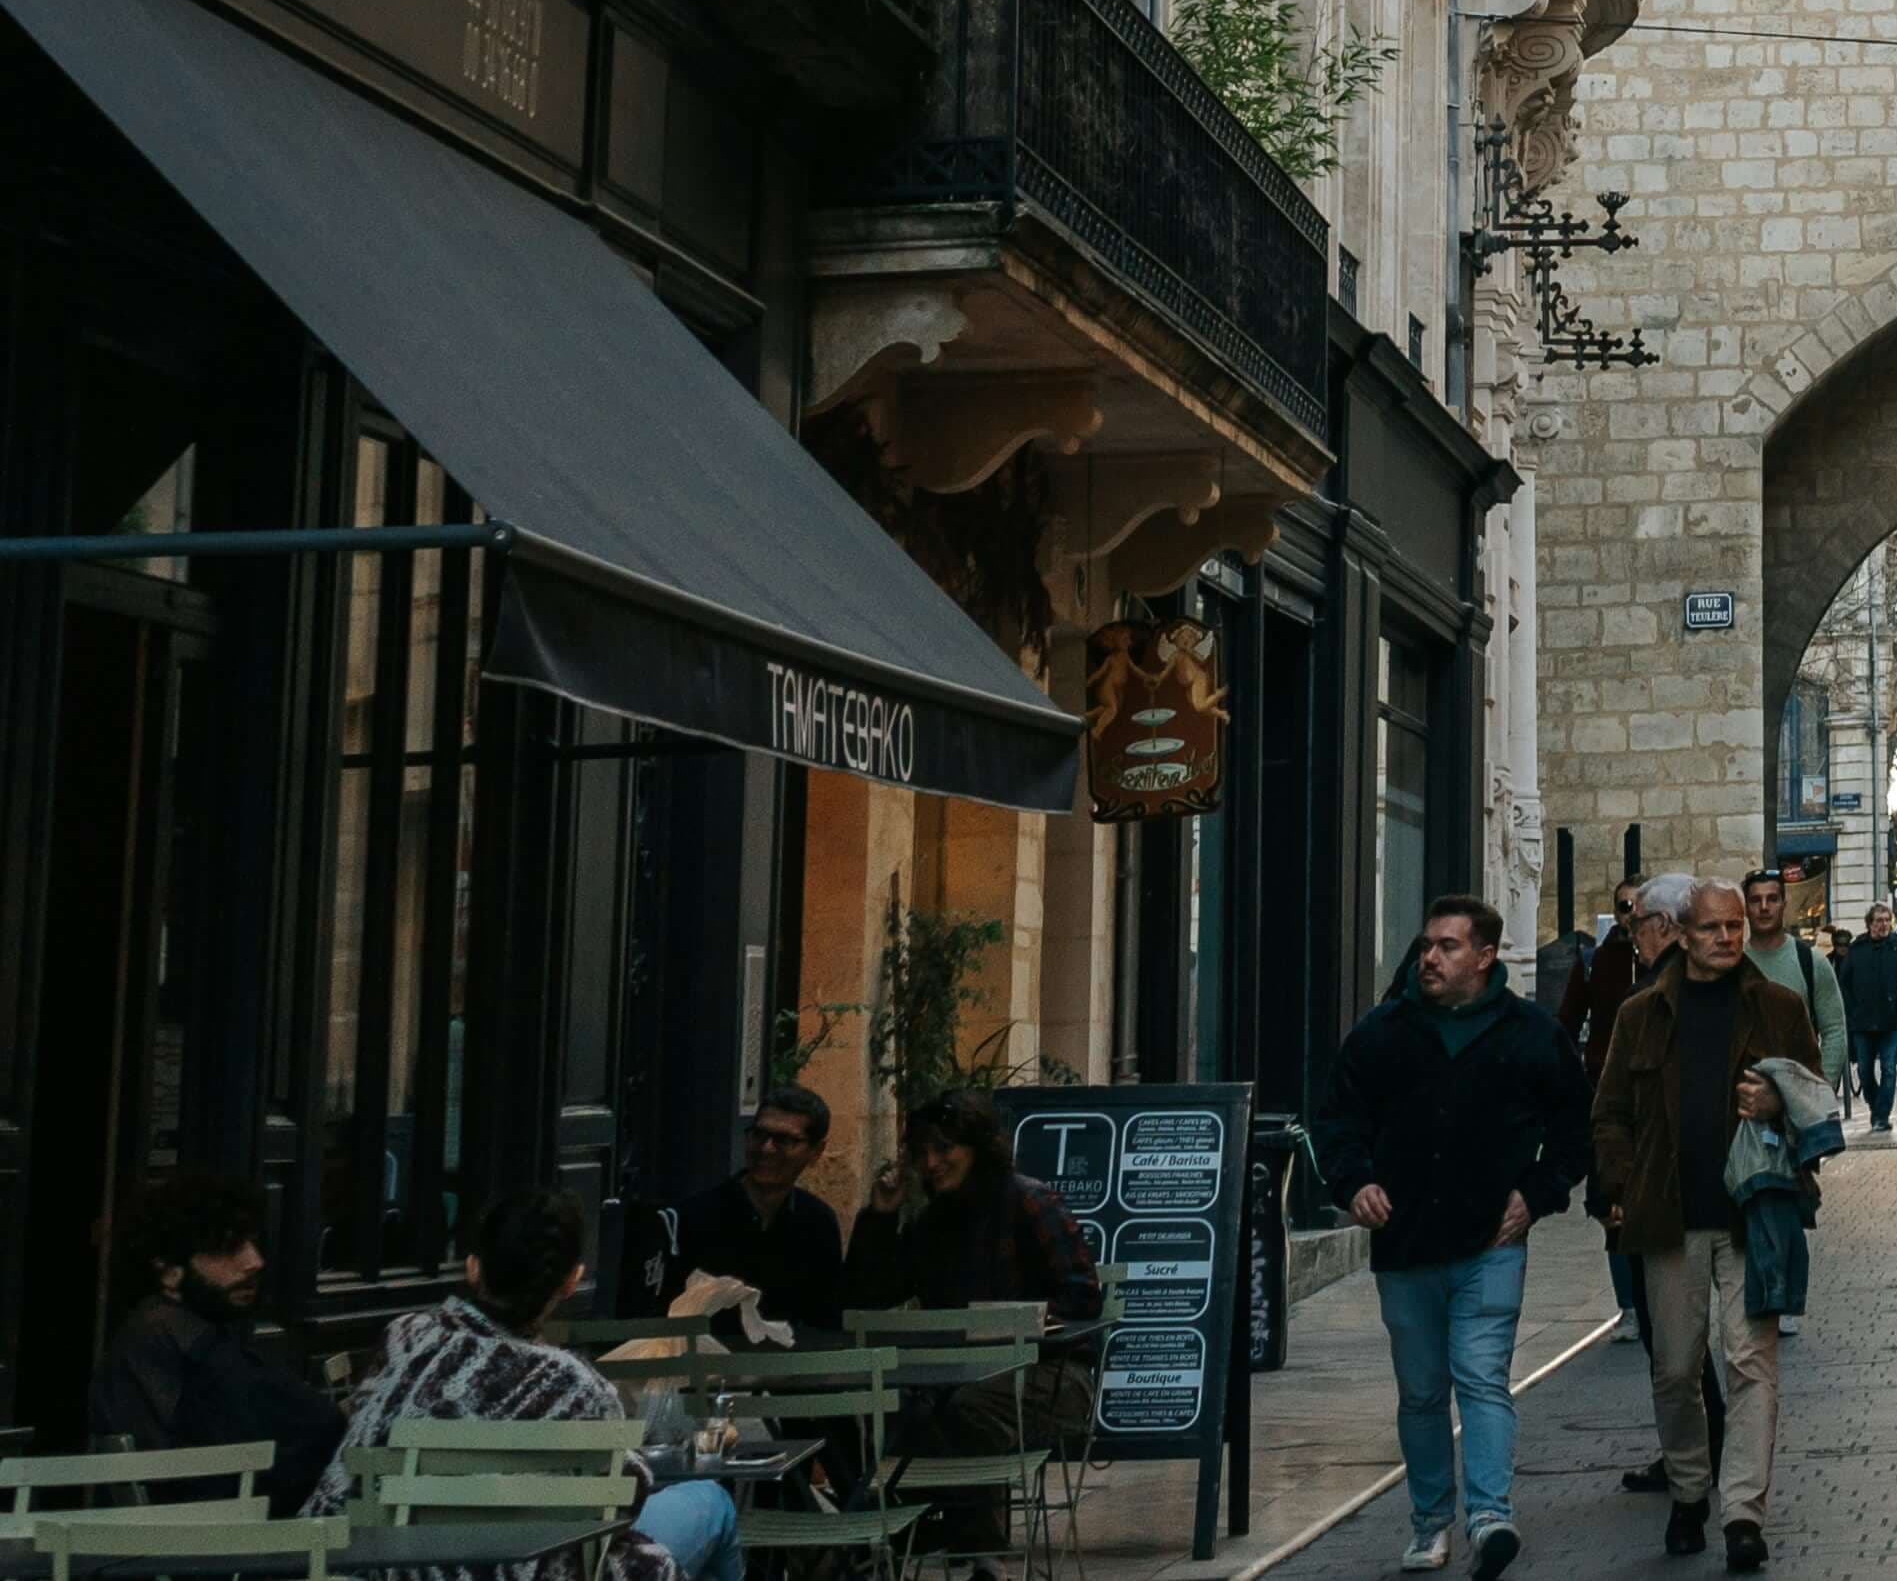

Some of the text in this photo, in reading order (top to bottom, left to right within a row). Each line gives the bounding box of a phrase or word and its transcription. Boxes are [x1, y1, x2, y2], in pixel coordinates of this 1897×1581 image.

[1697, 597, 1721, 609] RUE
[766, 662, 914, 782] TAMATEBAKO
[1043, 1123, 1087, 1176] T
[1132, 1154, 1159, 1167] Café
[1168, 1154, 1210, 1166] Barista
[1144, 1263, 1178, 1275] Sucré
[1126, 1372, 1182, 1386] Boutique
